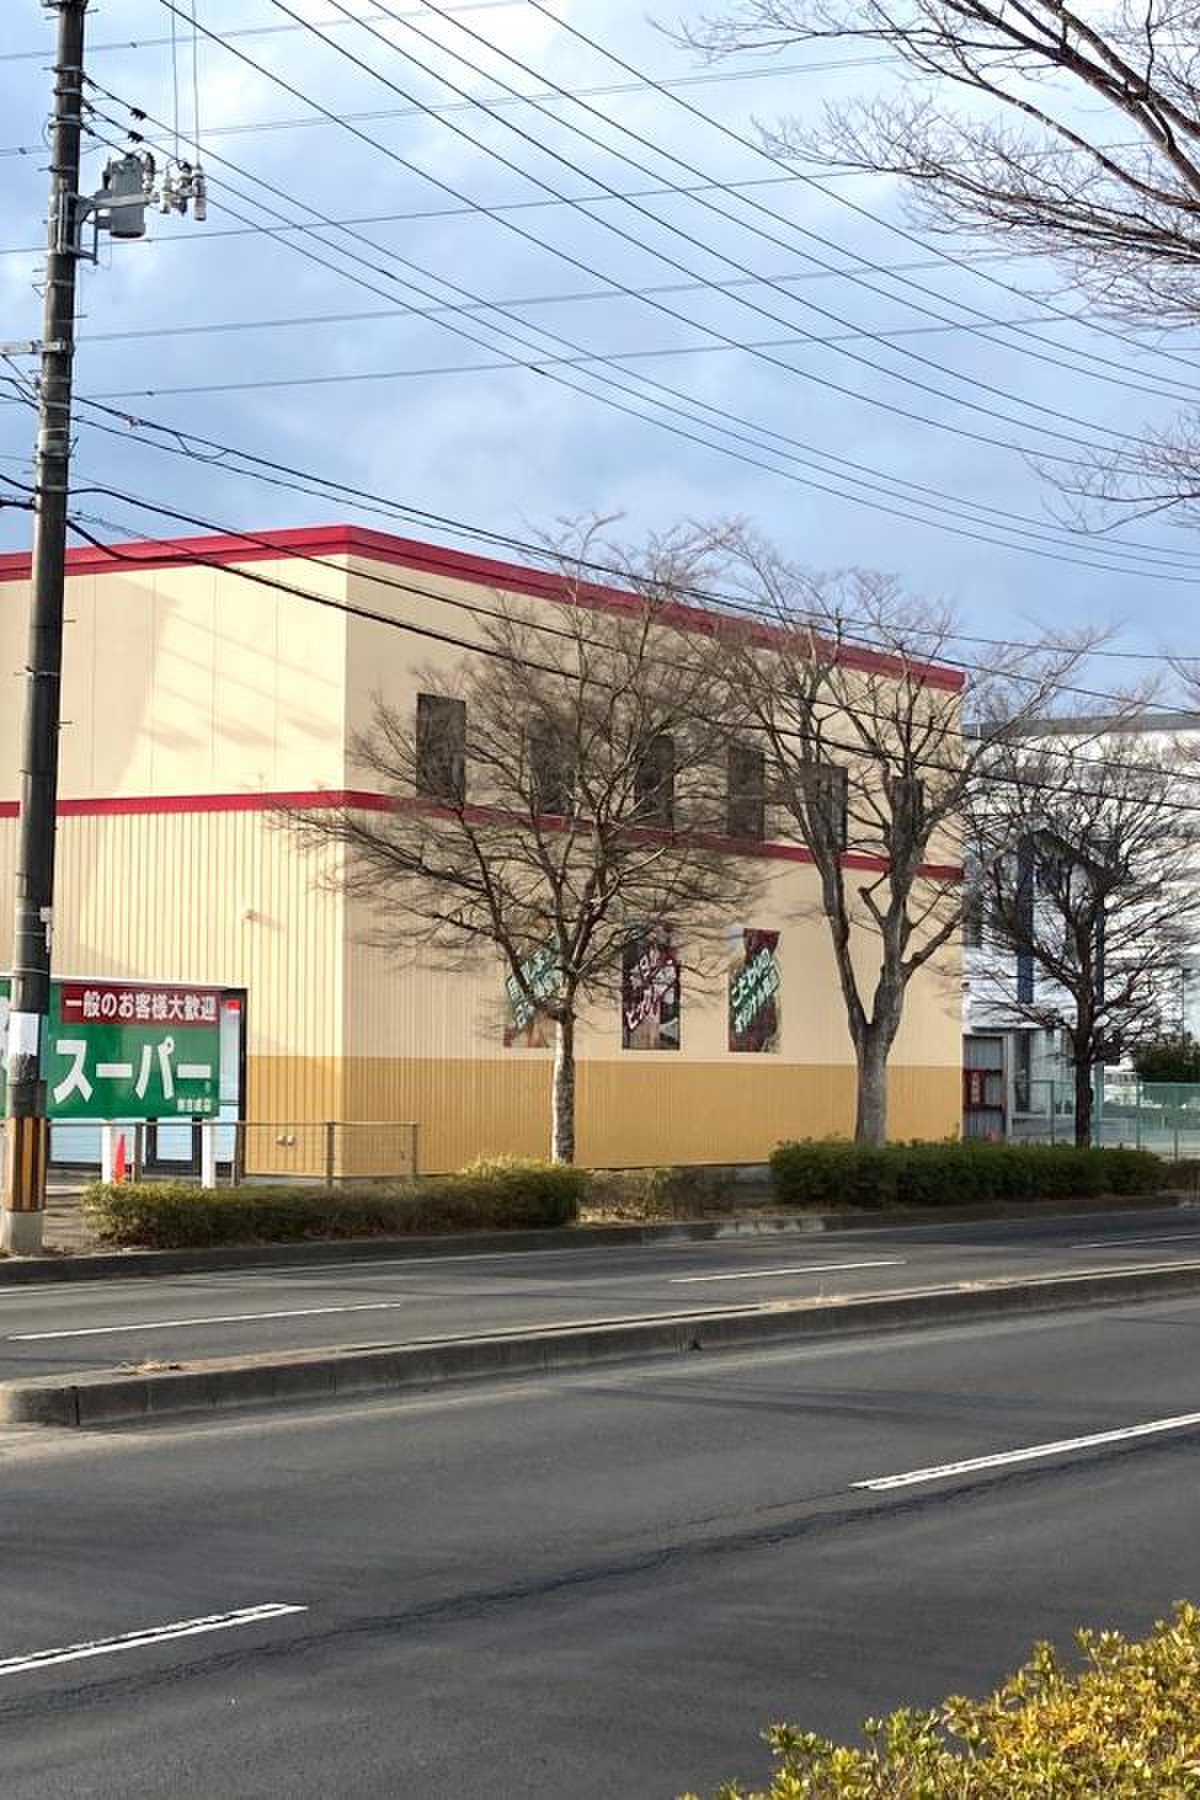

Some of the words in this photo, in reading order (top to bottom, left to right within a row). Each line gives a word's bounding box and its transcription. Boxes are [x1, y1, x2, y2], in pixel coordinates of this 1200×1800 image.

[65, 989, 218, 1021] 一般のお客様大歓迎
